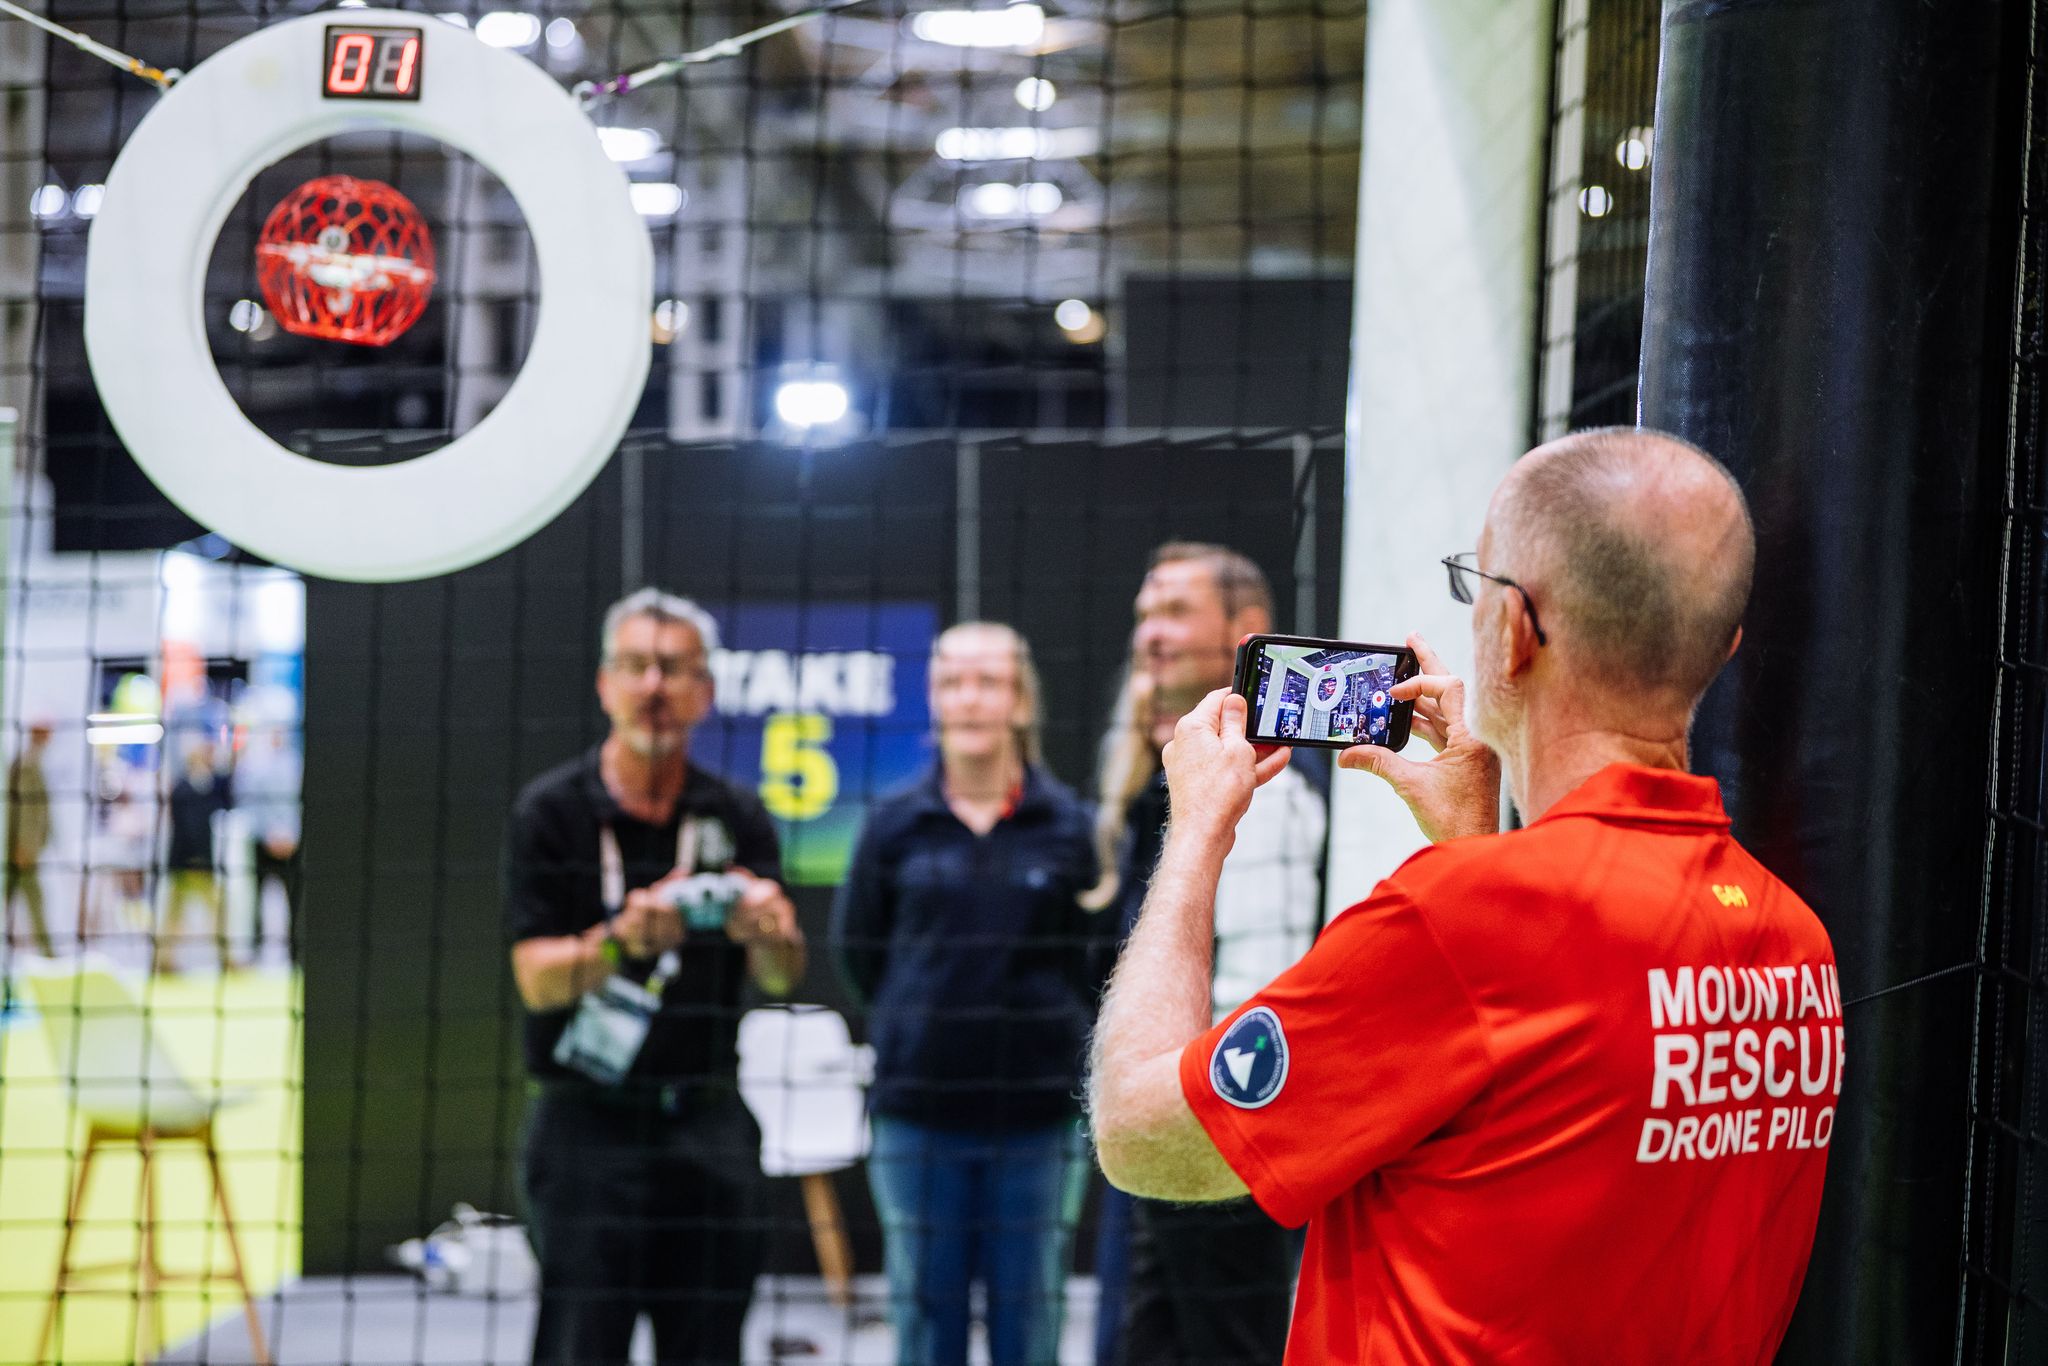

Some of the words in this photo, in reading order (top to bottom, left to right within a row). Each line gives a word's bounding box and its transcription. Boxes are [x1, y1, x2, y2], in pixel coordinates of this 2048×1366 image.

[328, 33, 418, 93] 01
[711, 648, 895, 717] TAKE
[758, 712, 839, 821] 5
[1648, 963, 1842, 1028] MOUNTAIN
[1650, 1026, 1846, 1109] RESCUE
[1636, 1109, 1762, 1163] DRONE
[1767, 1106, 1836, 1151] PILO
